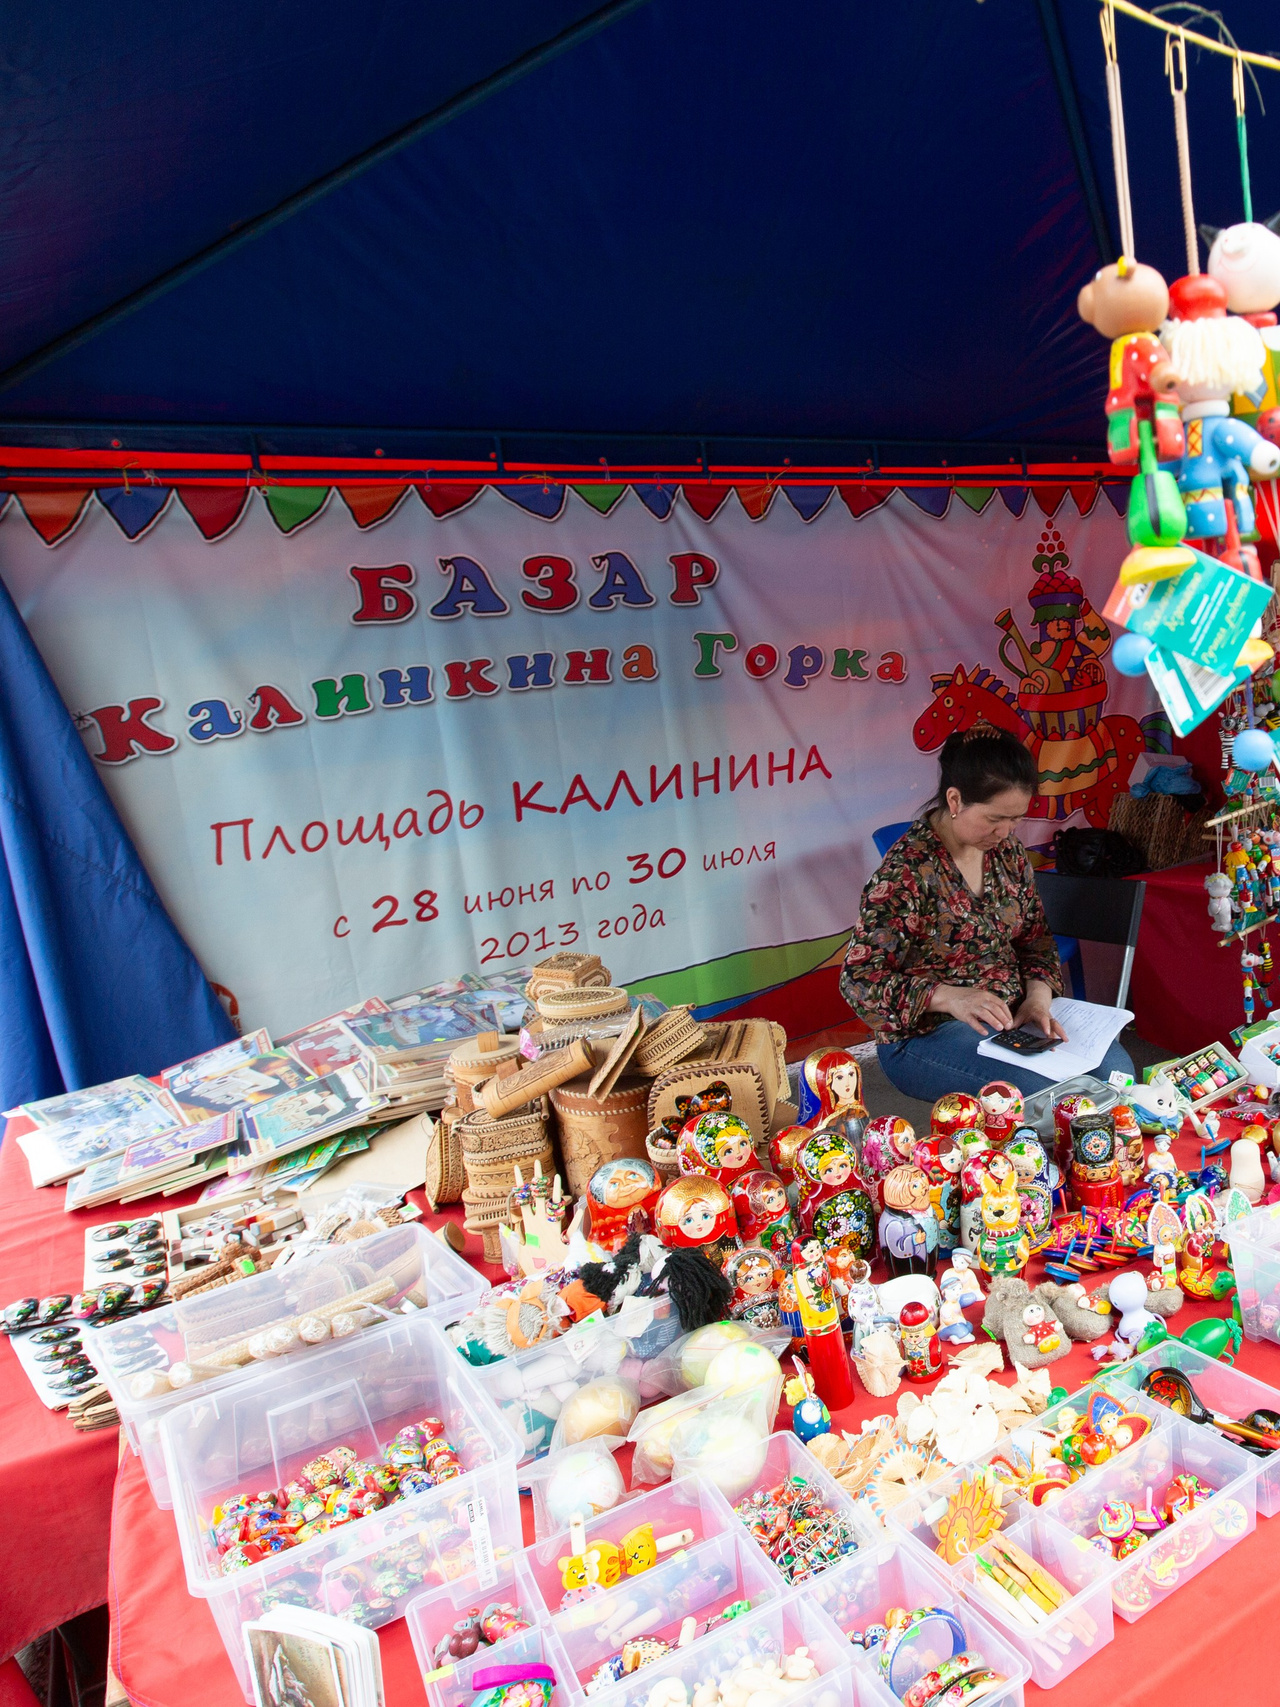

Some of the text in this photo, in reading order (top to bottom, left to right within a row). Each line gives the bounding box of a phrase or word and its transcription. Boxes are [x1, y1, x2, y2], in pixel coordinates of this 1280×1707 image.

[350, 551, 719, 624] БАЗАР
[80, 632, 907, 764] Калинкина Горка
[210, 744, 832, 866] Площадь КАЛИНИНА
[333, 841, 777, 937] с 28 июня по 30 июля
[480, 904, 666, 964] 2013 года
